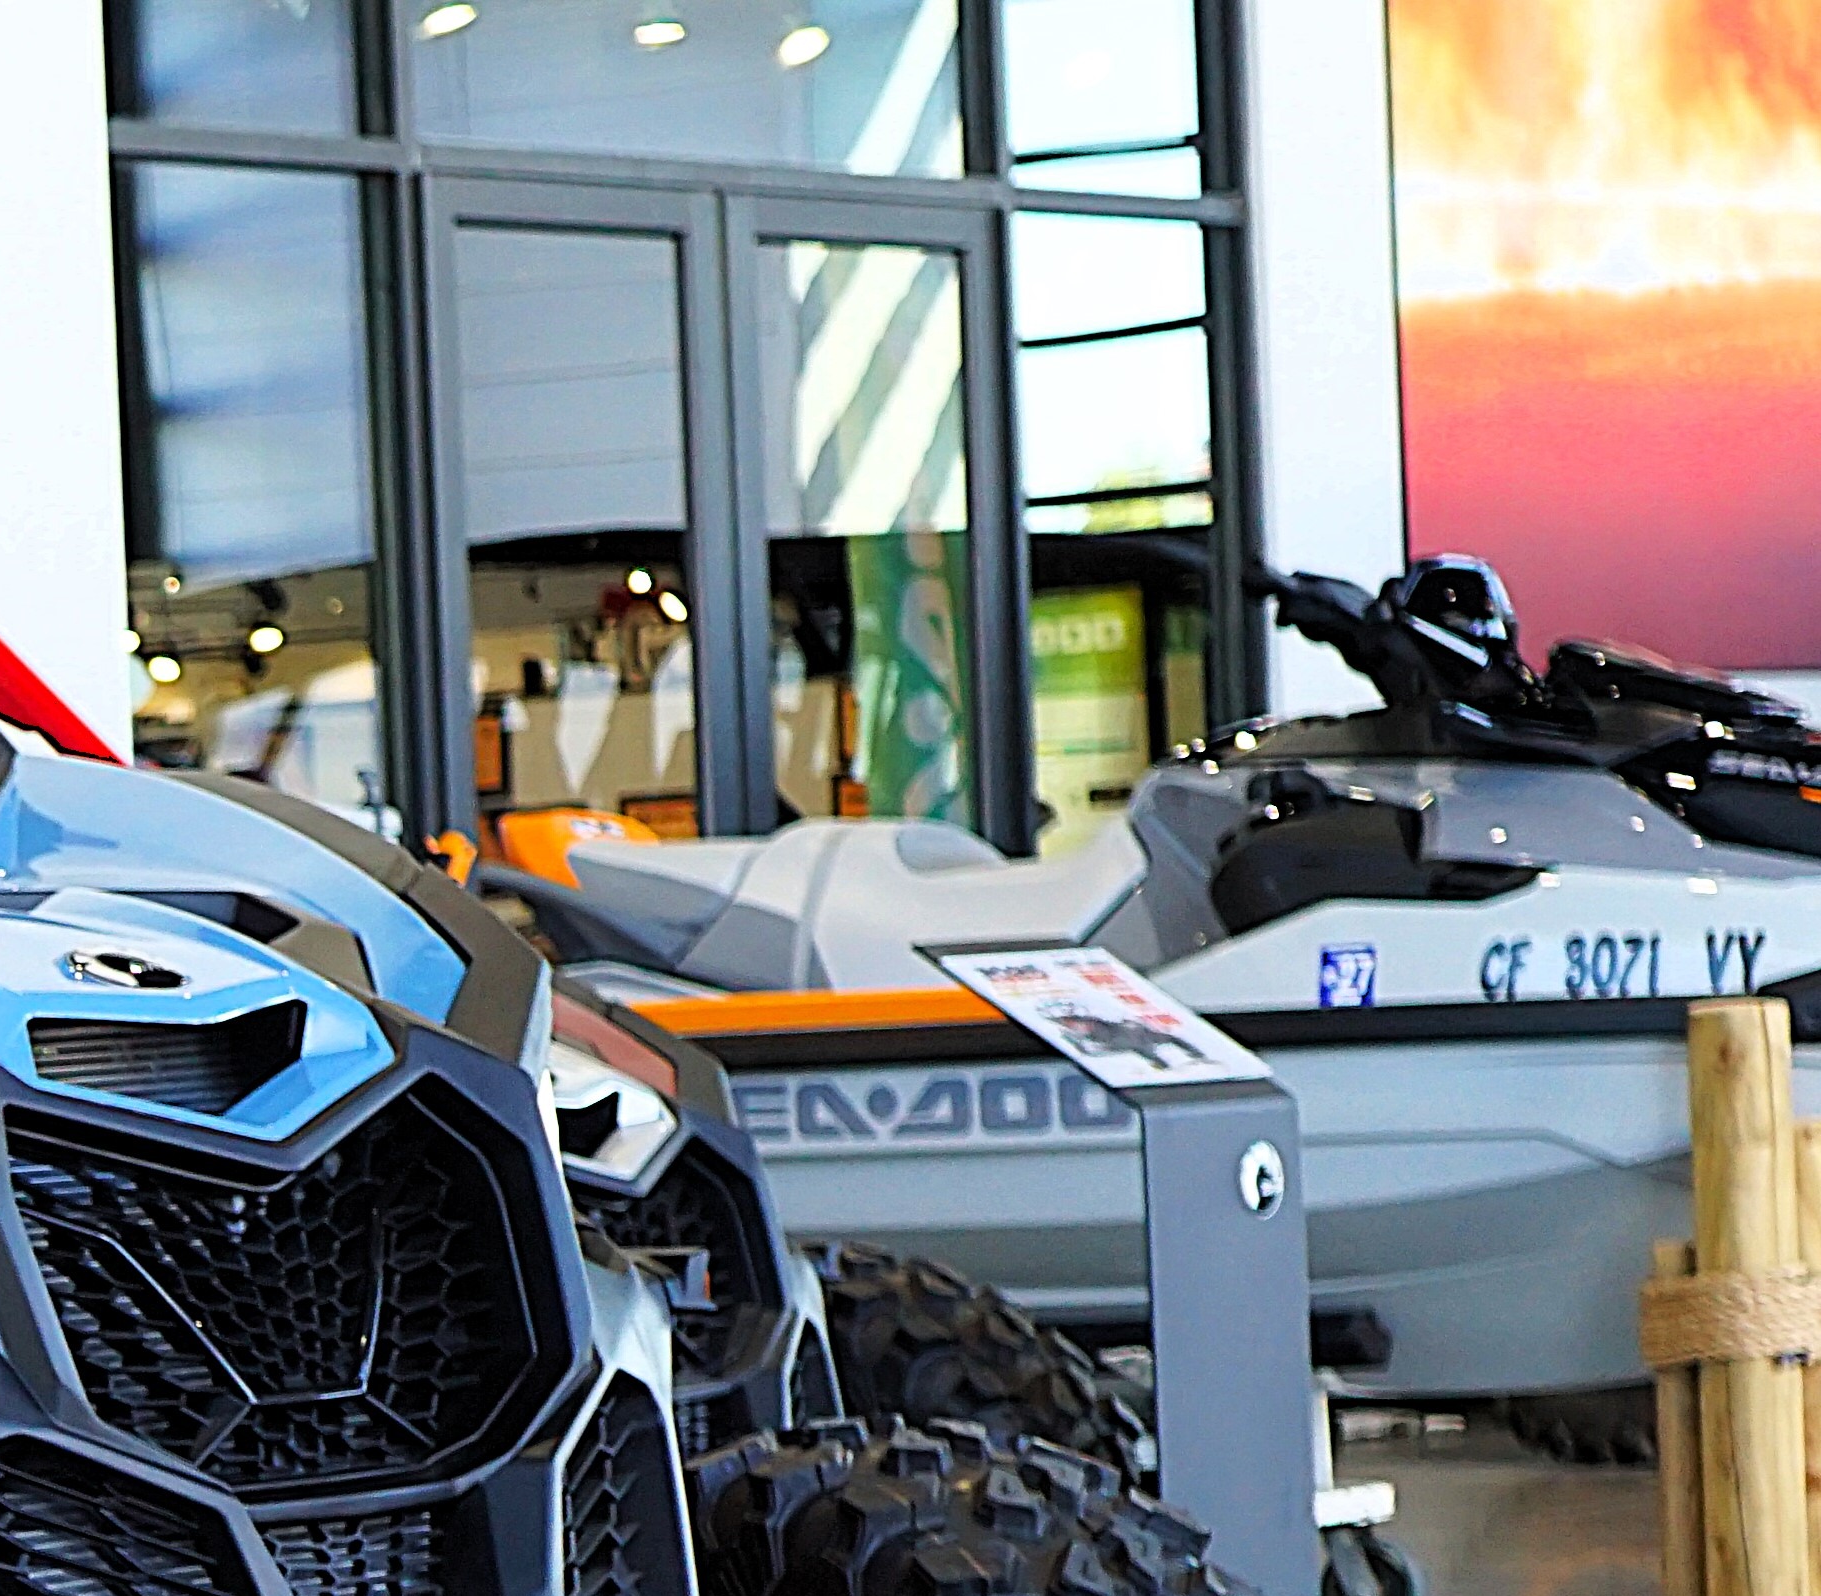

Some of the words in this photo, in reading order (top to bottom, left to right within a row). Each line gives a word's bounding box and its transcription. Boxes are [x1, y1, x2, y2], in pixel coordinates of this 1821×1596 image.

[1480, 935, 1533, 1001] CF
[1564, 930, 1661, 999] 3071
[1705, 927, 1766, 997] VY
